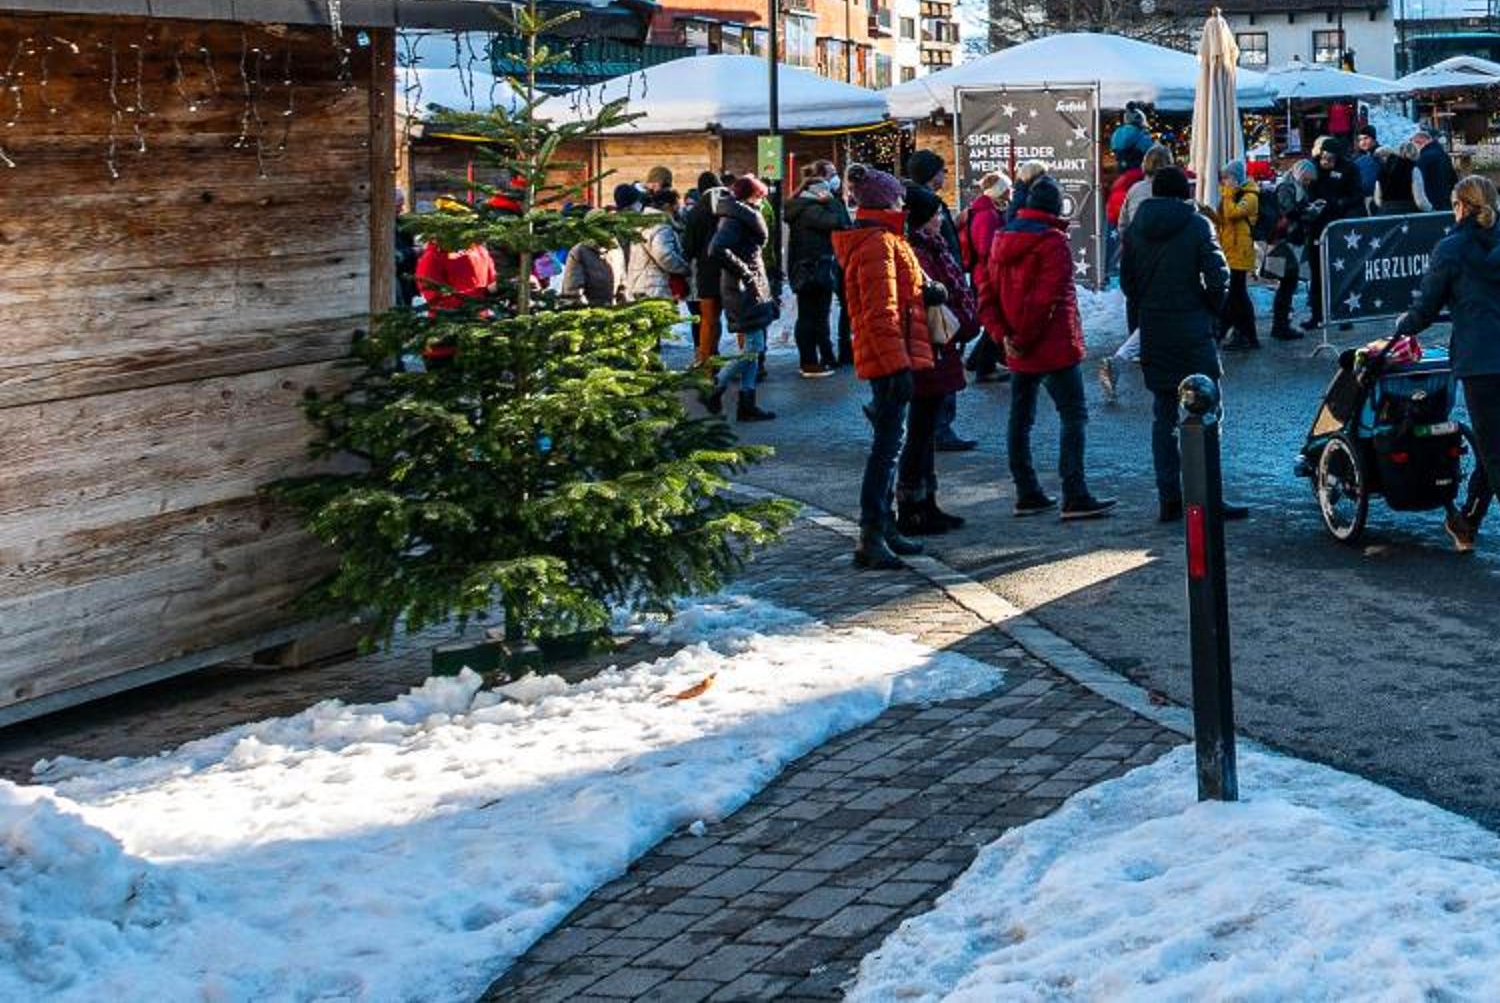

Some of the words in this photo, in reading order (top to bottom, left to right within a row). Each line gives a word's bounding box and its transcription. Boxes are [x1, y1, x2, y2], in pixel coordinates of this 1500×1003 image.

[968, 135, 1010, 146] SICHER
[969, 147, 987, 158] AM
[1365, 253, 1430, 281] HERZLICH
